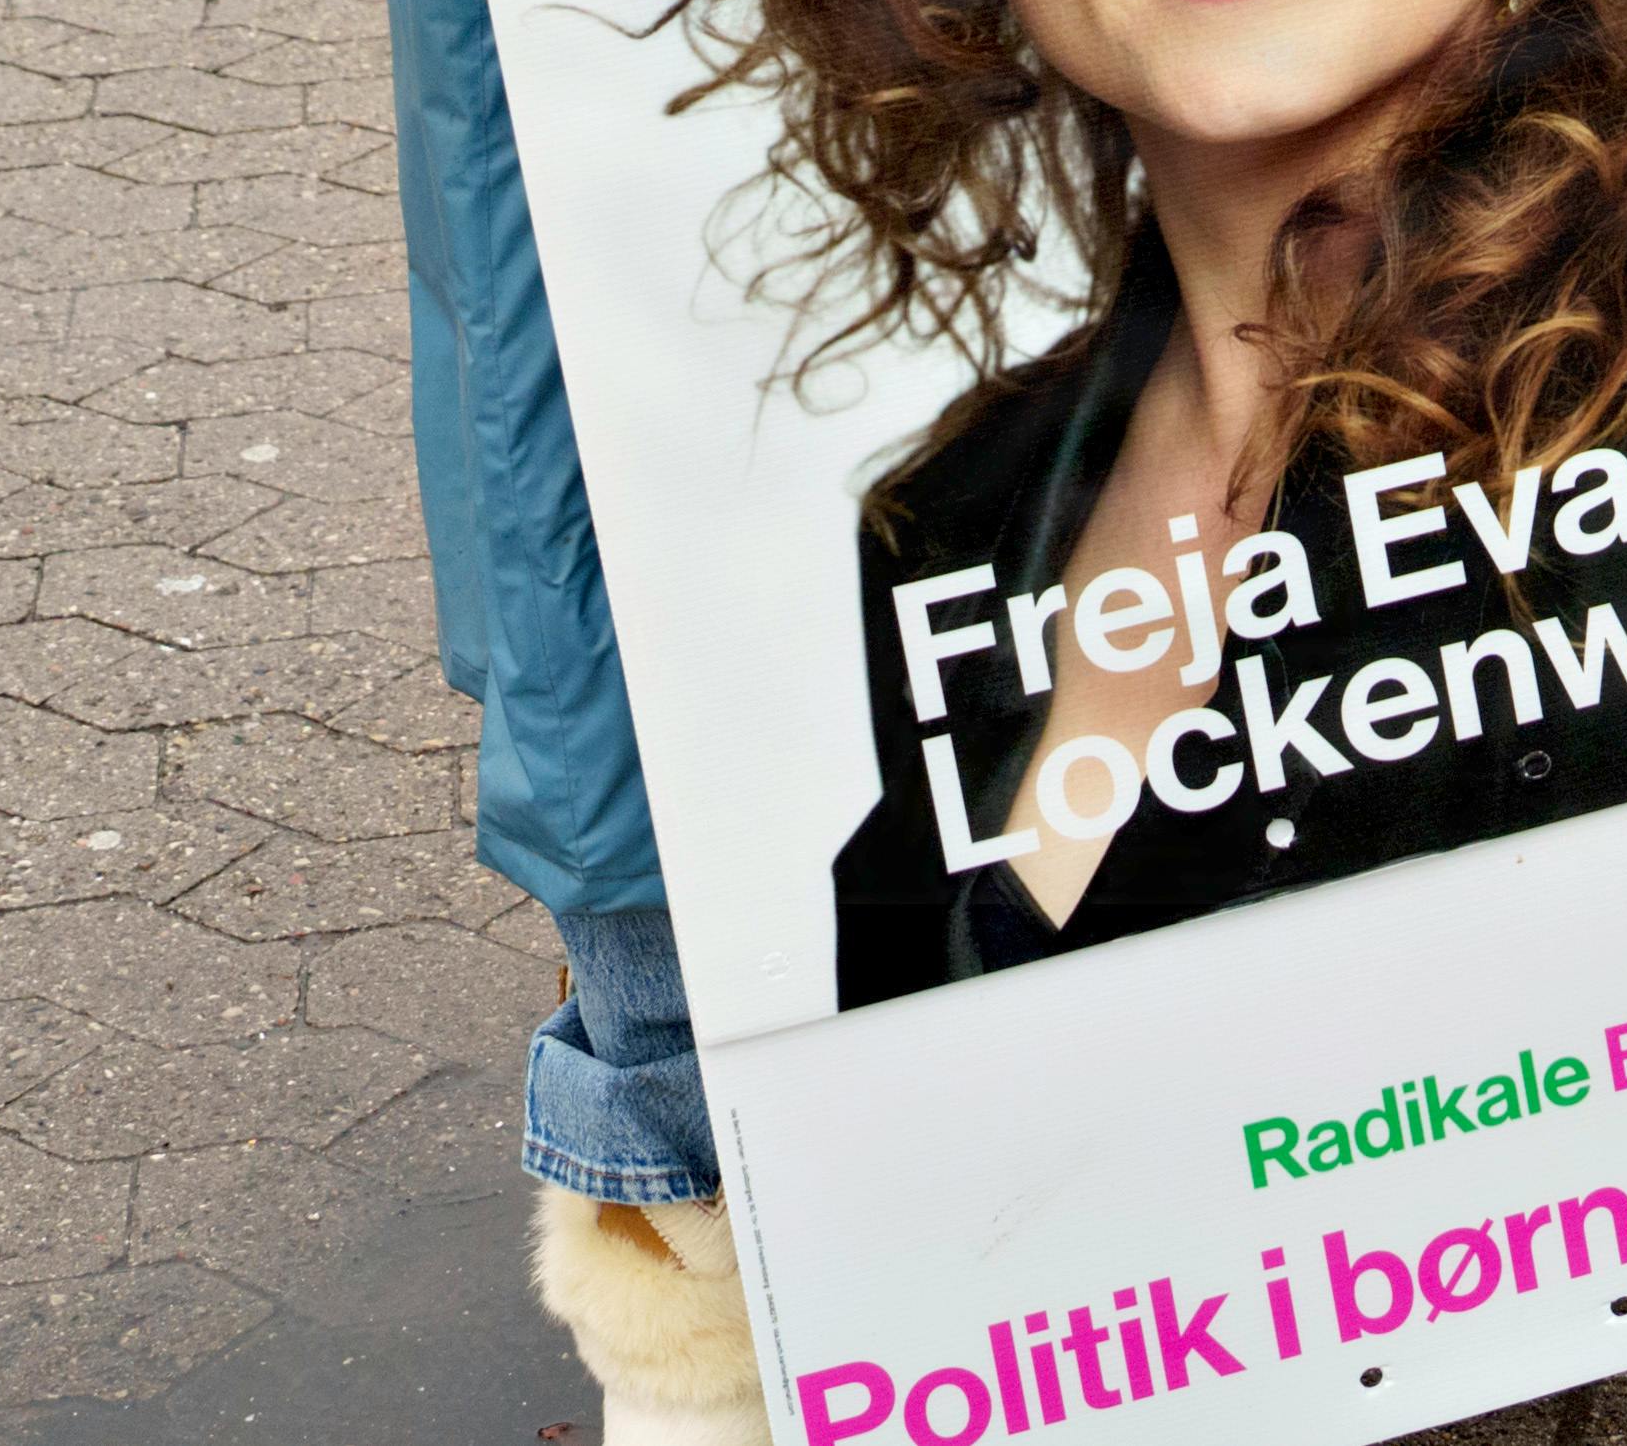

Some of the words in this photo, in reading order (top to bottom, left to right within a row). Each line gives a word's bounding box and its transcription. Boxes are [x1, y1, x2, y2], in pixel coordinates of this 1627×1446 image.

[892, 514, 1320, 722] Freja
[1242, 1050, 1591, 1190] Radikale
[796, 1276, 1247, 1446] Politik
[1261, 1246, 1303, 1361] i
